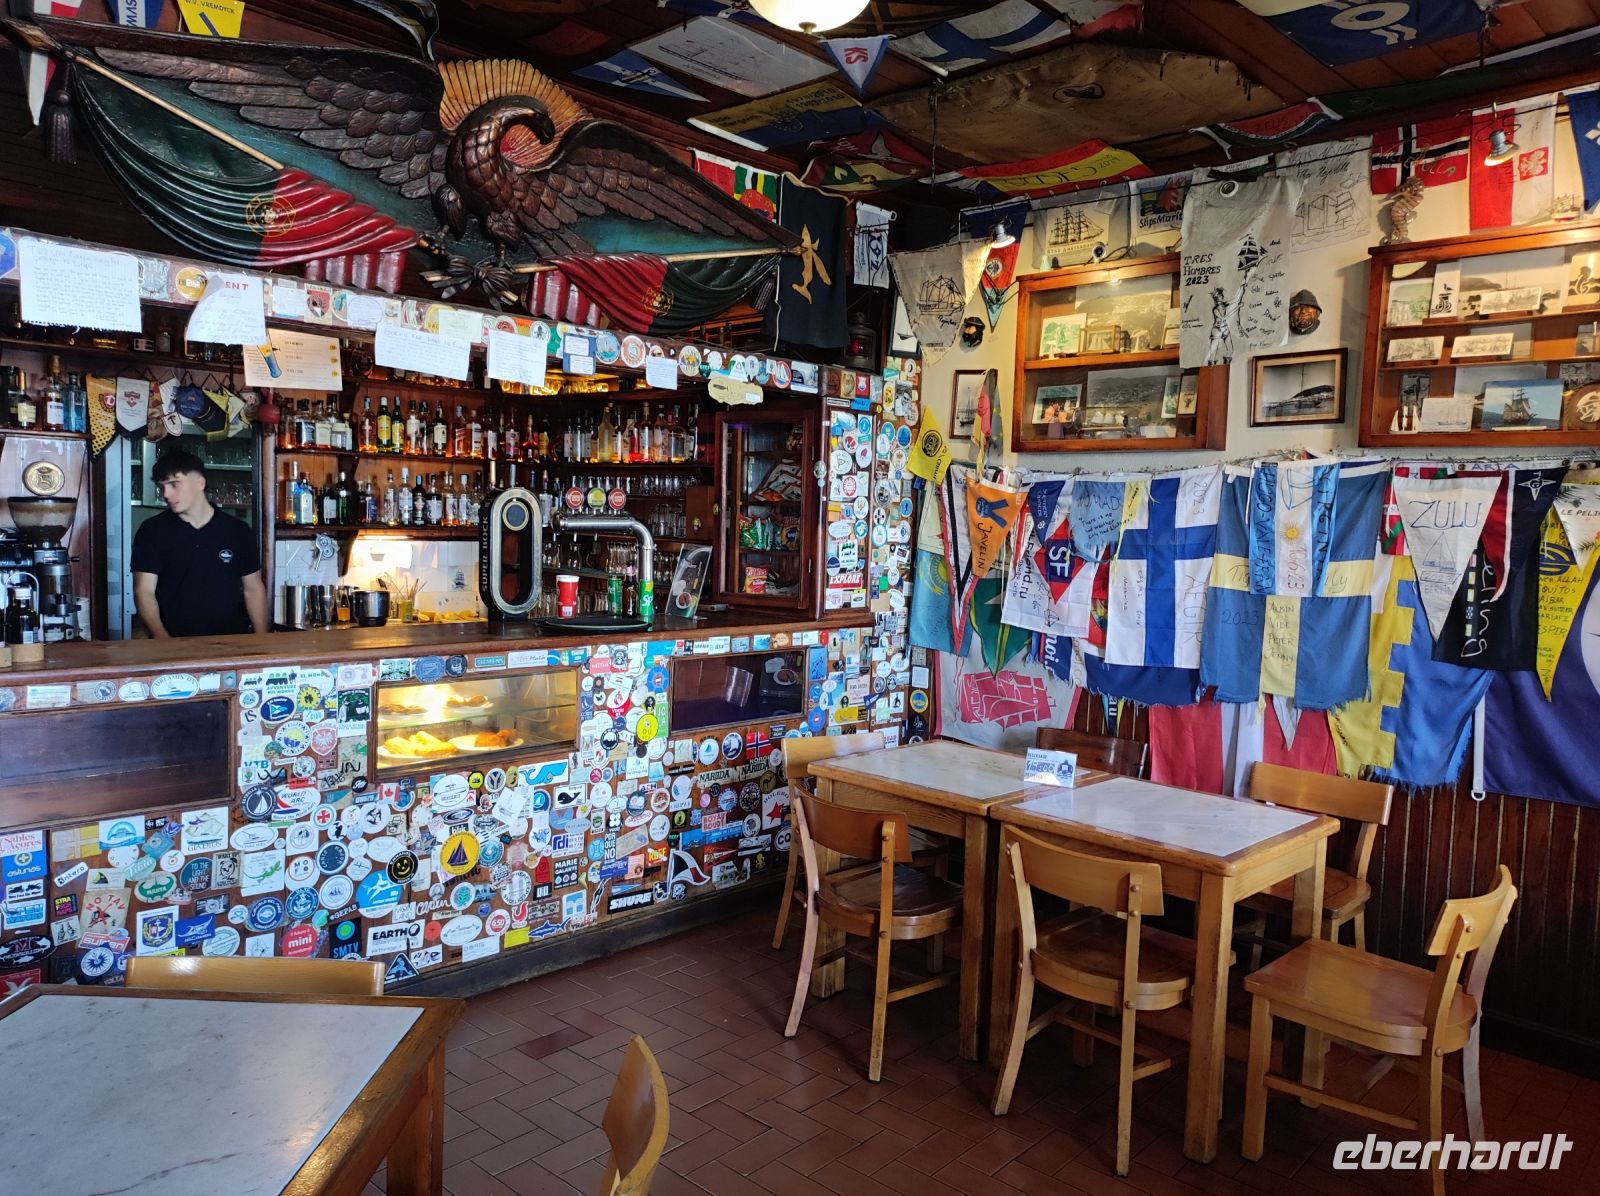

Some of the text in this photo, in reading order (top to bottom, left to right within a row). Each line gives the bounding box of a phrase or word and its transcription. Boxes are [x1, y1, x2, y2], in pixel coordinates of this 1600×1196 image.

[200, 1, 236, 15] VREMDYCK
[843, 47, 869, 65] KS
[1184, 253, 1214, 266] TRES
[1184, 265, 1222, 277] HOMBRES
[1185, 275, 1210, 287] 2023
[1408, 499, 1484, 528] ZULU
[977, 522, 994, 570] JAVELIN
[481, 515, 489, 593] SUPER BOCK
[830, 574, 861, 584] EXPLORE
[244, 759, 270, 769] VTB
[281, 791, 307, 799] WORLD
[605, 848, 616, 860] NO
[555, 858, 578, 869] MARIE
[7, 865, 42, 878] asturias
[555, 866, 578, 875] GALANTE
[86, 894, 126, 911] NO TAV
[609, 892, 652, 910] SHURE
[288, 934, 313, 948] mini
[372, 928, 407, 941] EARTH
[333, 941, 360, 958] SMTV
